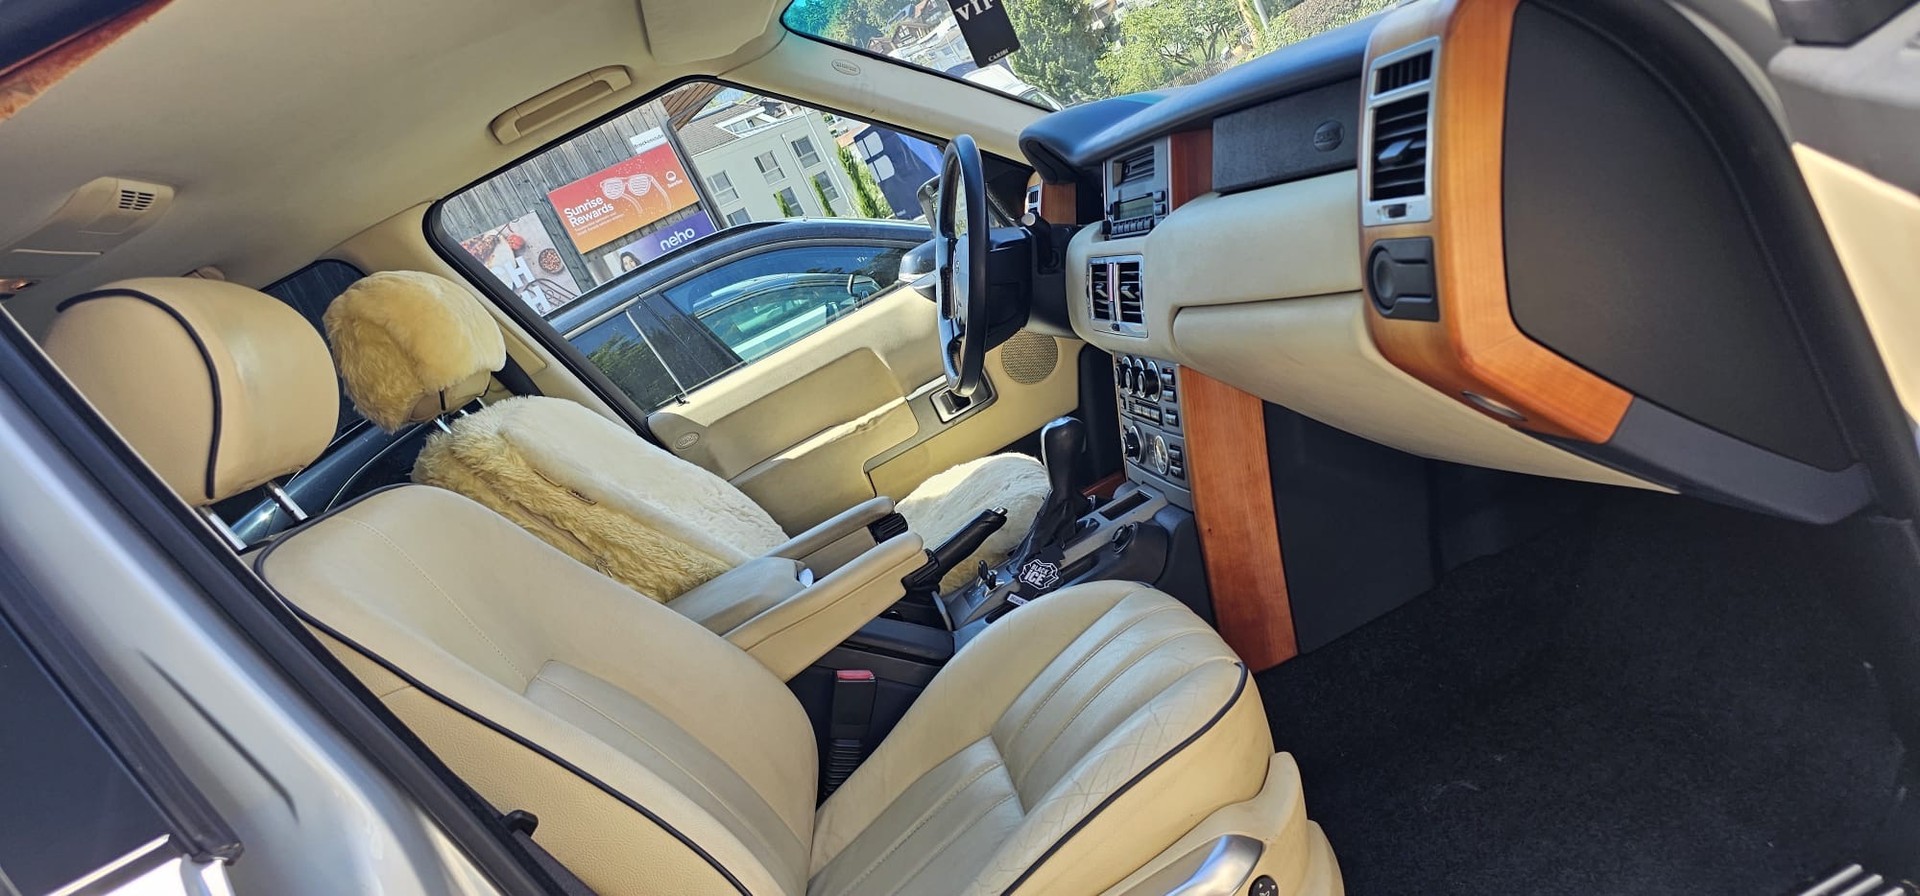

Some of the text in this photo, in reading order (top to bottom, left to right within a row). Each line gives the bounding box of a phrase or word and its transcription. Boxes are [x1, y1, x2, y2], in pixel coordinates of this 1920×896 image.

[564, 196, 604, 218] Sunrise
[568, 203, 614, 228] Rewards
[660, 228, 695, 250] neho
[1031, 563, 1050, 575] BLACK
